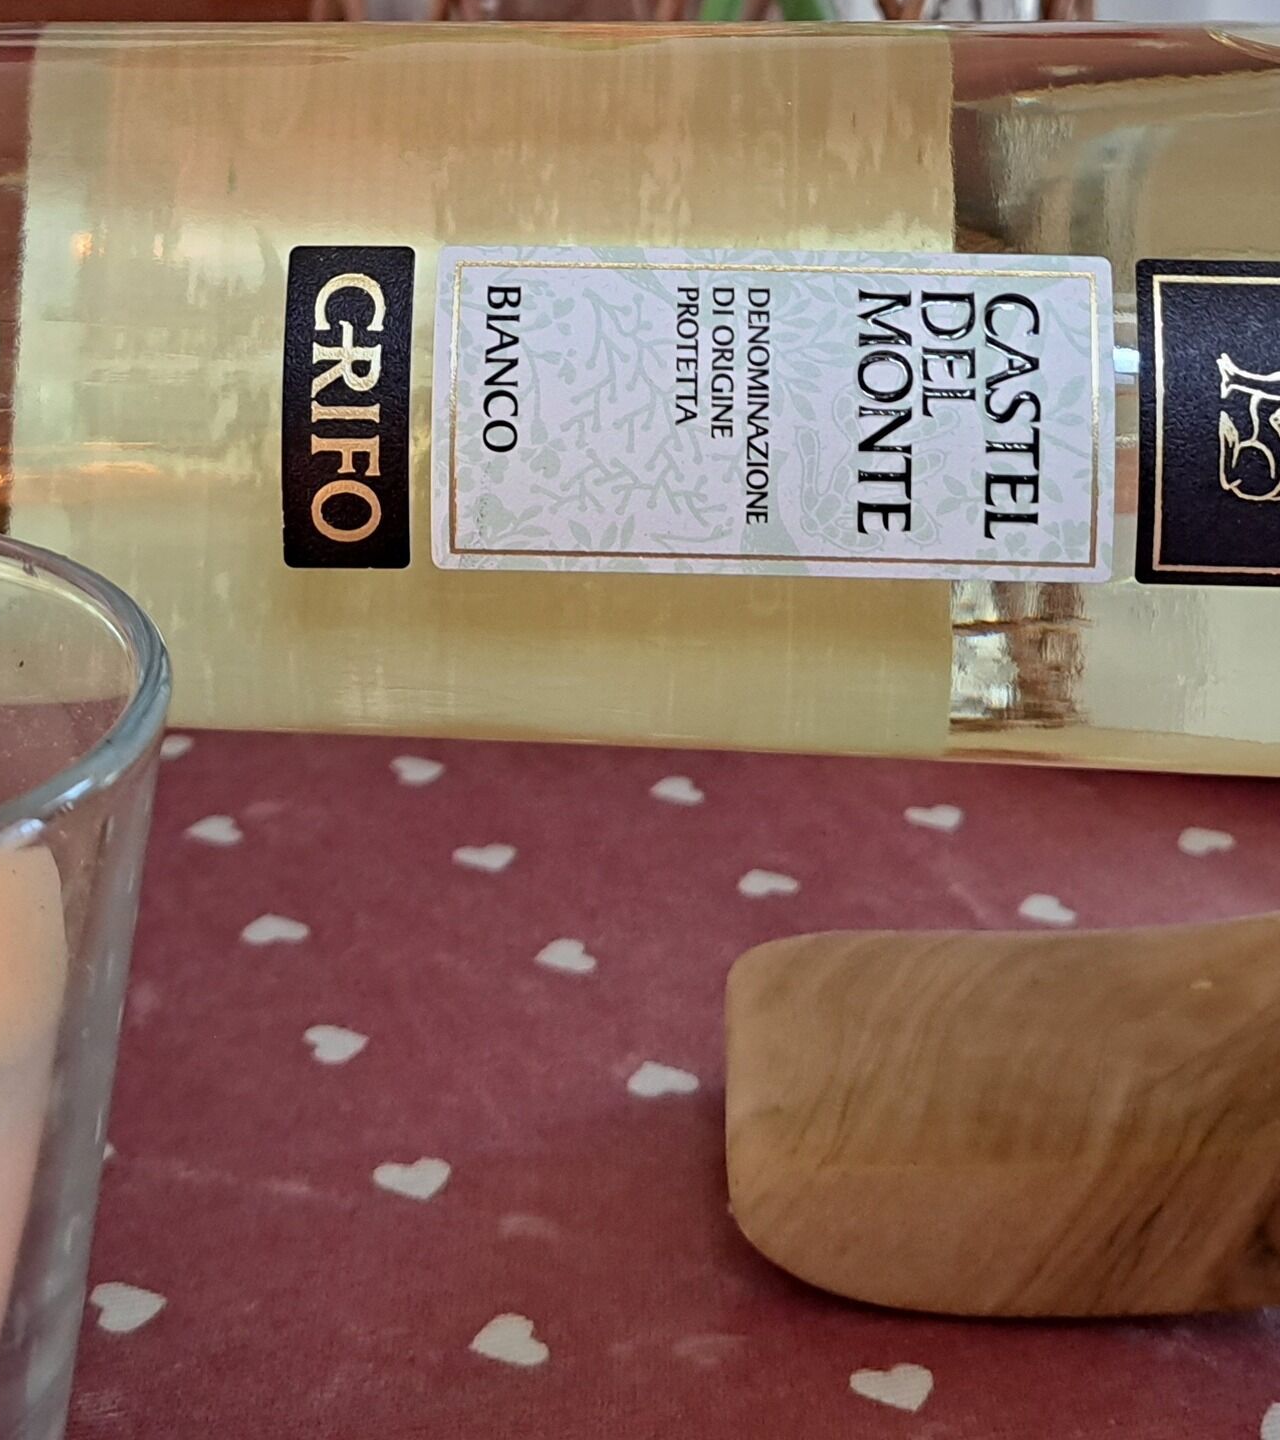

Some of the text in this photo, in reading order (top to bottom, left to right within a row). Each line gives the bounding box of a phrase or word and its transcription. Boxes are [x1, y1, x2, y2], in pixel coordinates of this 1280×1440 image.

[310, 271, 387, 543] GRIFO
[482, 285, 522, 454] BIANCO
[675, 287, 700, 426] PROTETTA
[711, 287, 735, 439] DI ORIGINE
[745, 287, 771, 525] DENOMINAZIONE
[856, 289, 914, 535] MONTE
[921, 290, 977, 418] DEL
[983, 292, 1042, 540] CASTEL
